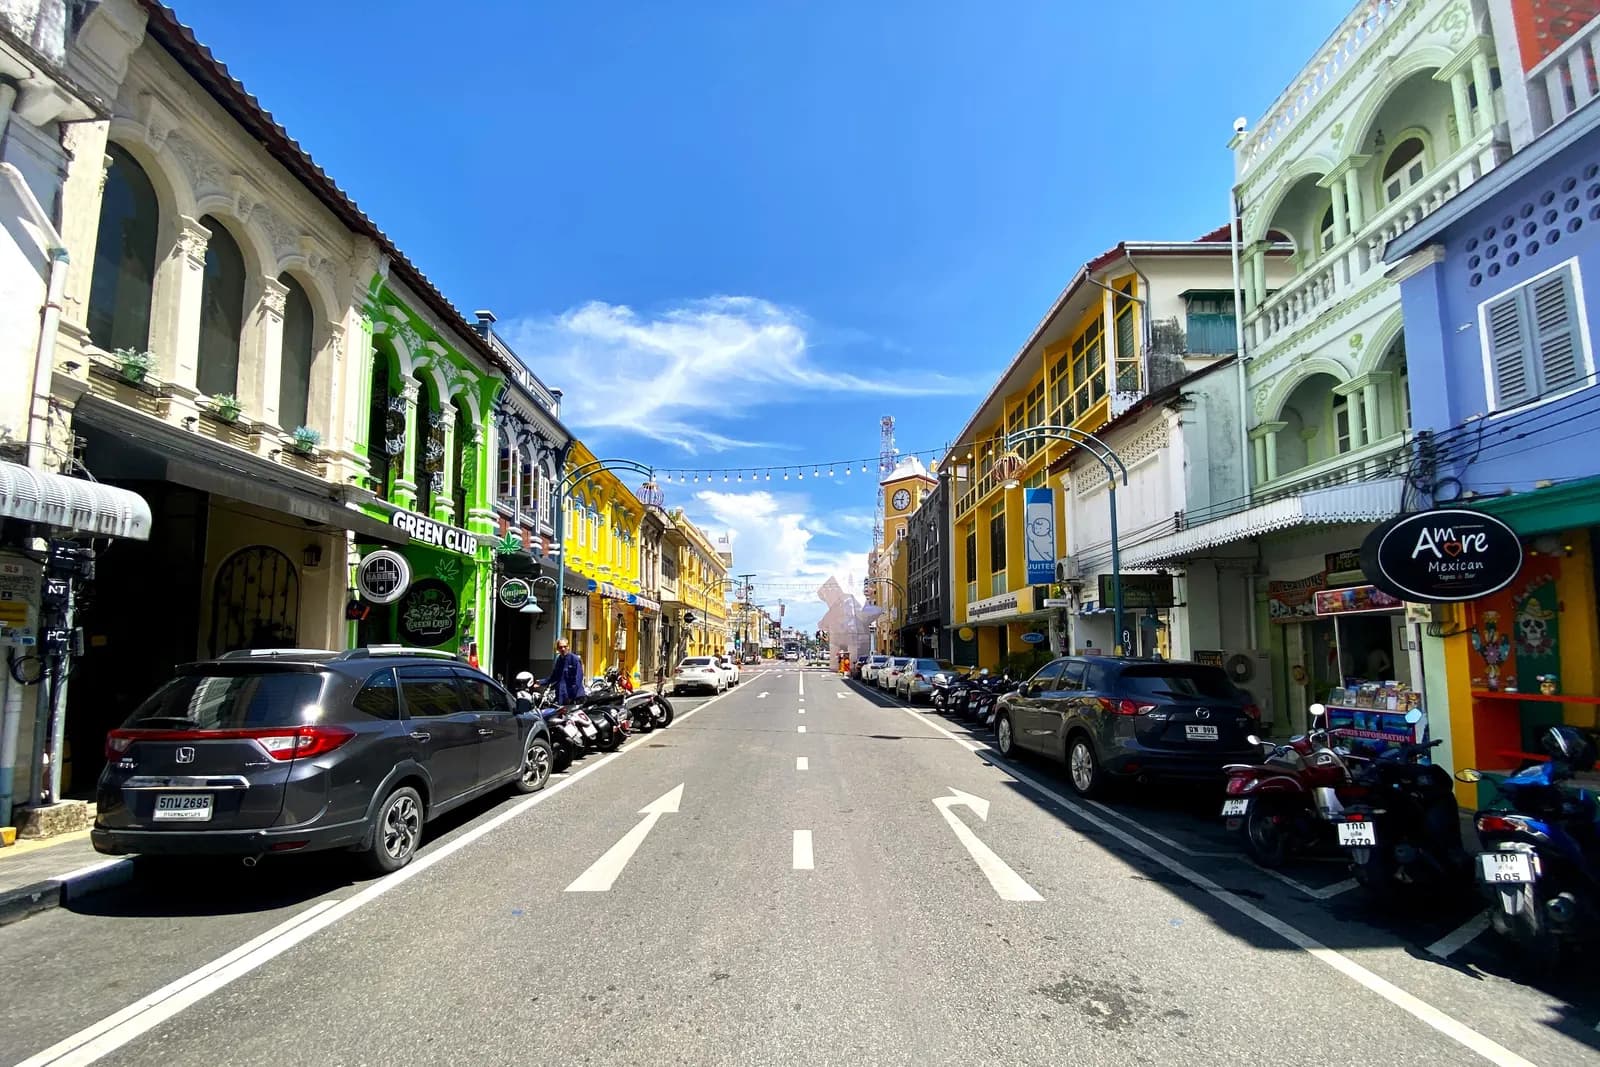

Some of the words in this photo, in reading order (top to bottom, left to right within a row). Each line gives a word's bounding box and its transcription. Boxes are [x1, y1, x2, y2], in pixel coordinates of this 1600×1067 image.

[393, 511, 443, 545] GREEN
[445, 529, 477, 555] CLUB
[1428, 559, 1484, 573] Mexican
[183, 797, 209, 808] 2695
